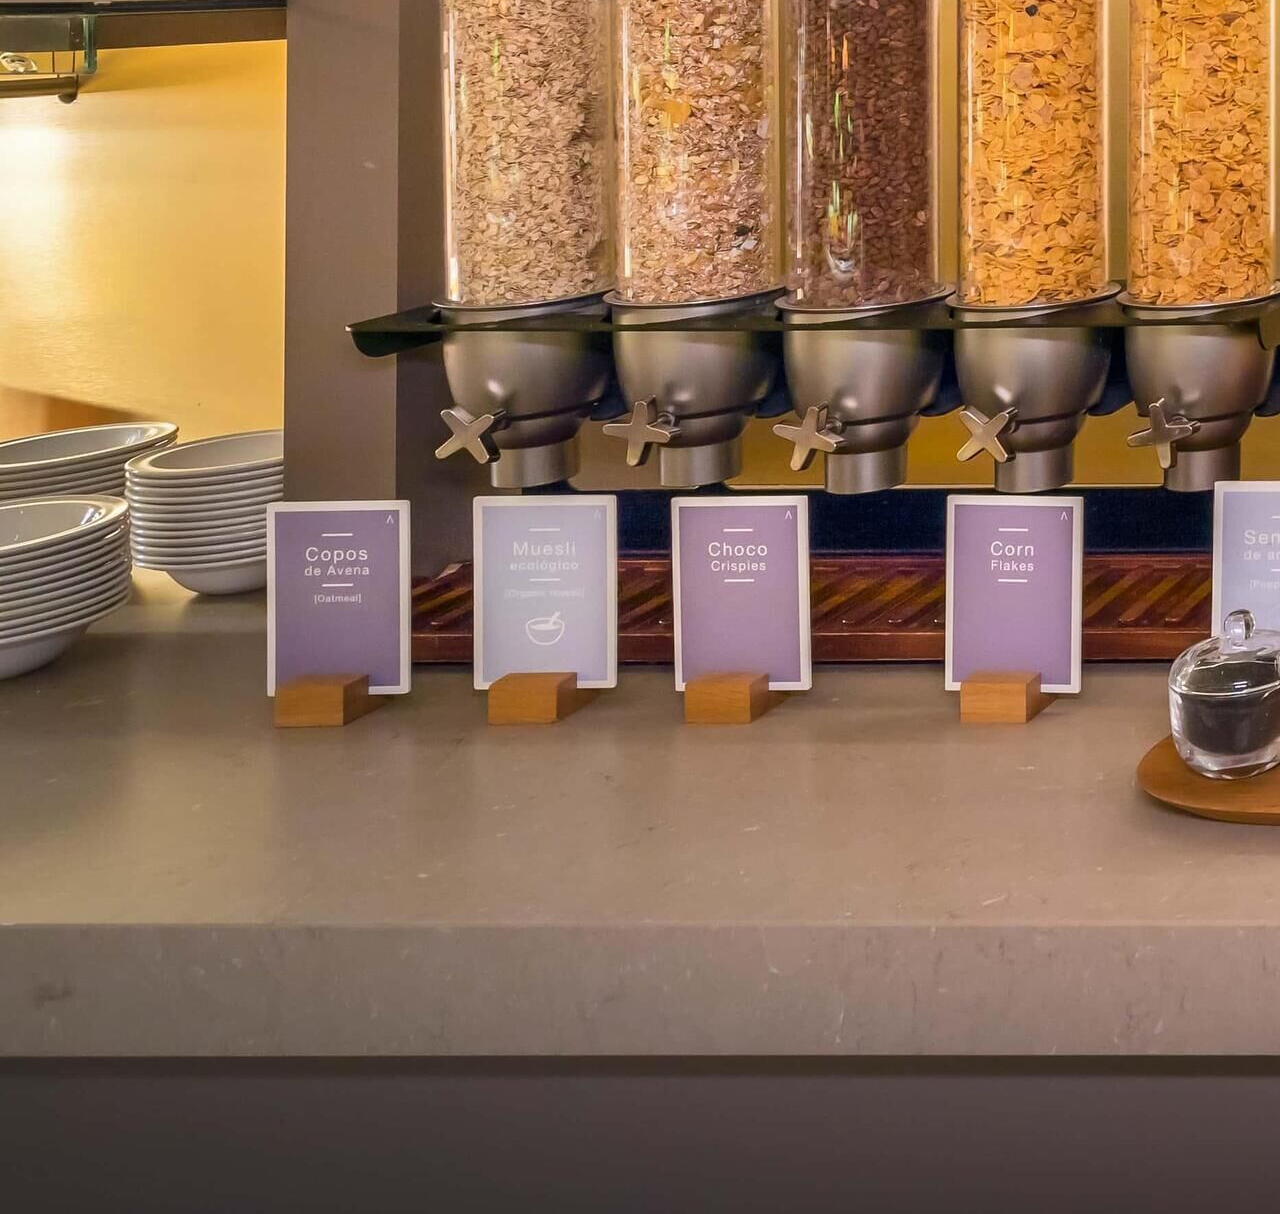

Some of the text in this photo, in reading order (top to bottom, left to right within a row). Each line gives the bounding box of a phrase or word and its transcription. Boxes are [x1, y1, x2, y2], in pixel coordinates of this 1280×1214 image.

[305, 546, 369, 565] Copos
[512, 540, 577, 557] Muesli
[708, 541, 768, 557] Choco
[990, 540, 1035, 556] Corn
[1243, 549, 1262, 561] de
[304, 565, 370, 577] de Avena
[711, 560, 767, 574] Crispies
[991, 559, 1035, 572] Flakes
